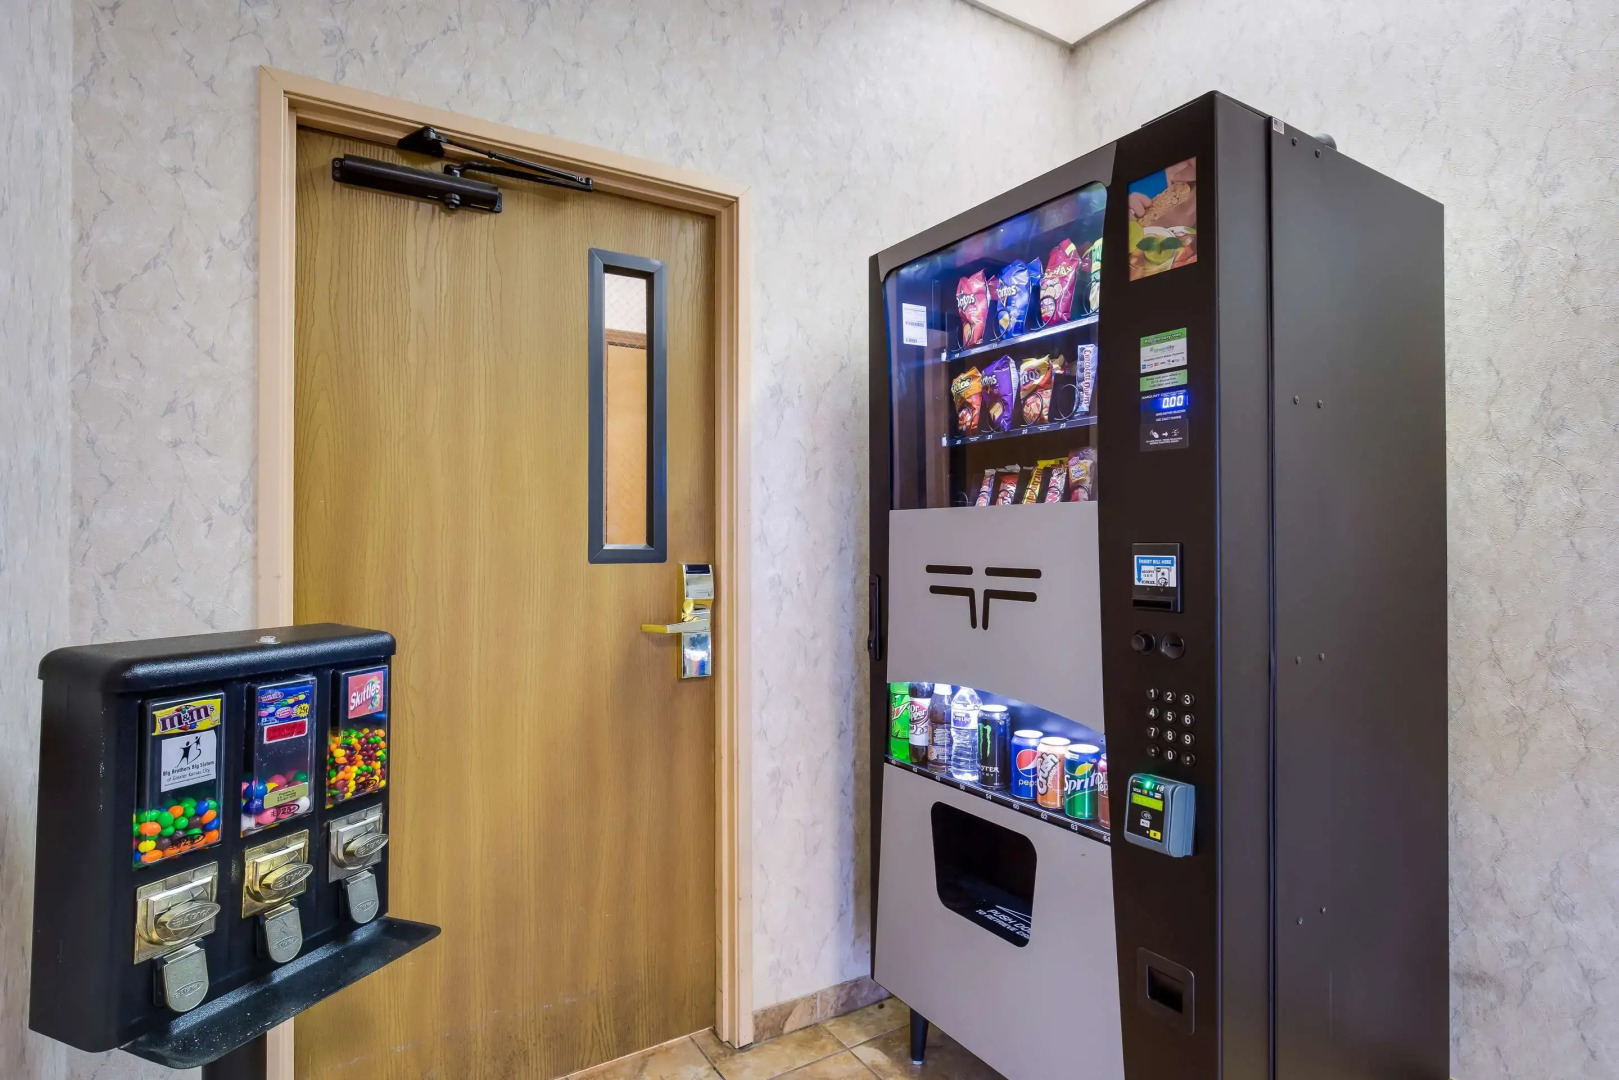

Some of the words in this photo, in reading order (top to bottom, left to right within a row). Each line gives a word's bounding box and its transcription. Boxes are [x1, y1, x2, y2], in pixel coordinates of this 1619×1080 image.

[349, 680, 380, 711] Skittles
[1149, 688, 1155, 698] 1
[1166, 691, 1173, 701] 2
[1184, 694, 1191, 705] 3
[1149, 707, 1155, 718] 4
[1167, 711, 1173, 722] 5
[1184, 714, 1191, 725] 6
[1150, 727, 1156, 737] 7
[1167, 730, 1173, 741] 8
[1184, 734, 1191, 745] 9
[1167, 750, 1173, 760] 0
[172, 766, 191, 775] Brothers
[200, 760, 215, 768] Sisters
[1037, 752, 1060, 796] Crush
[1041, 811, 1048, 819] 62
[1070, 823, 1078, 831] 63
[986, 908, 1017, 924] PUSH
